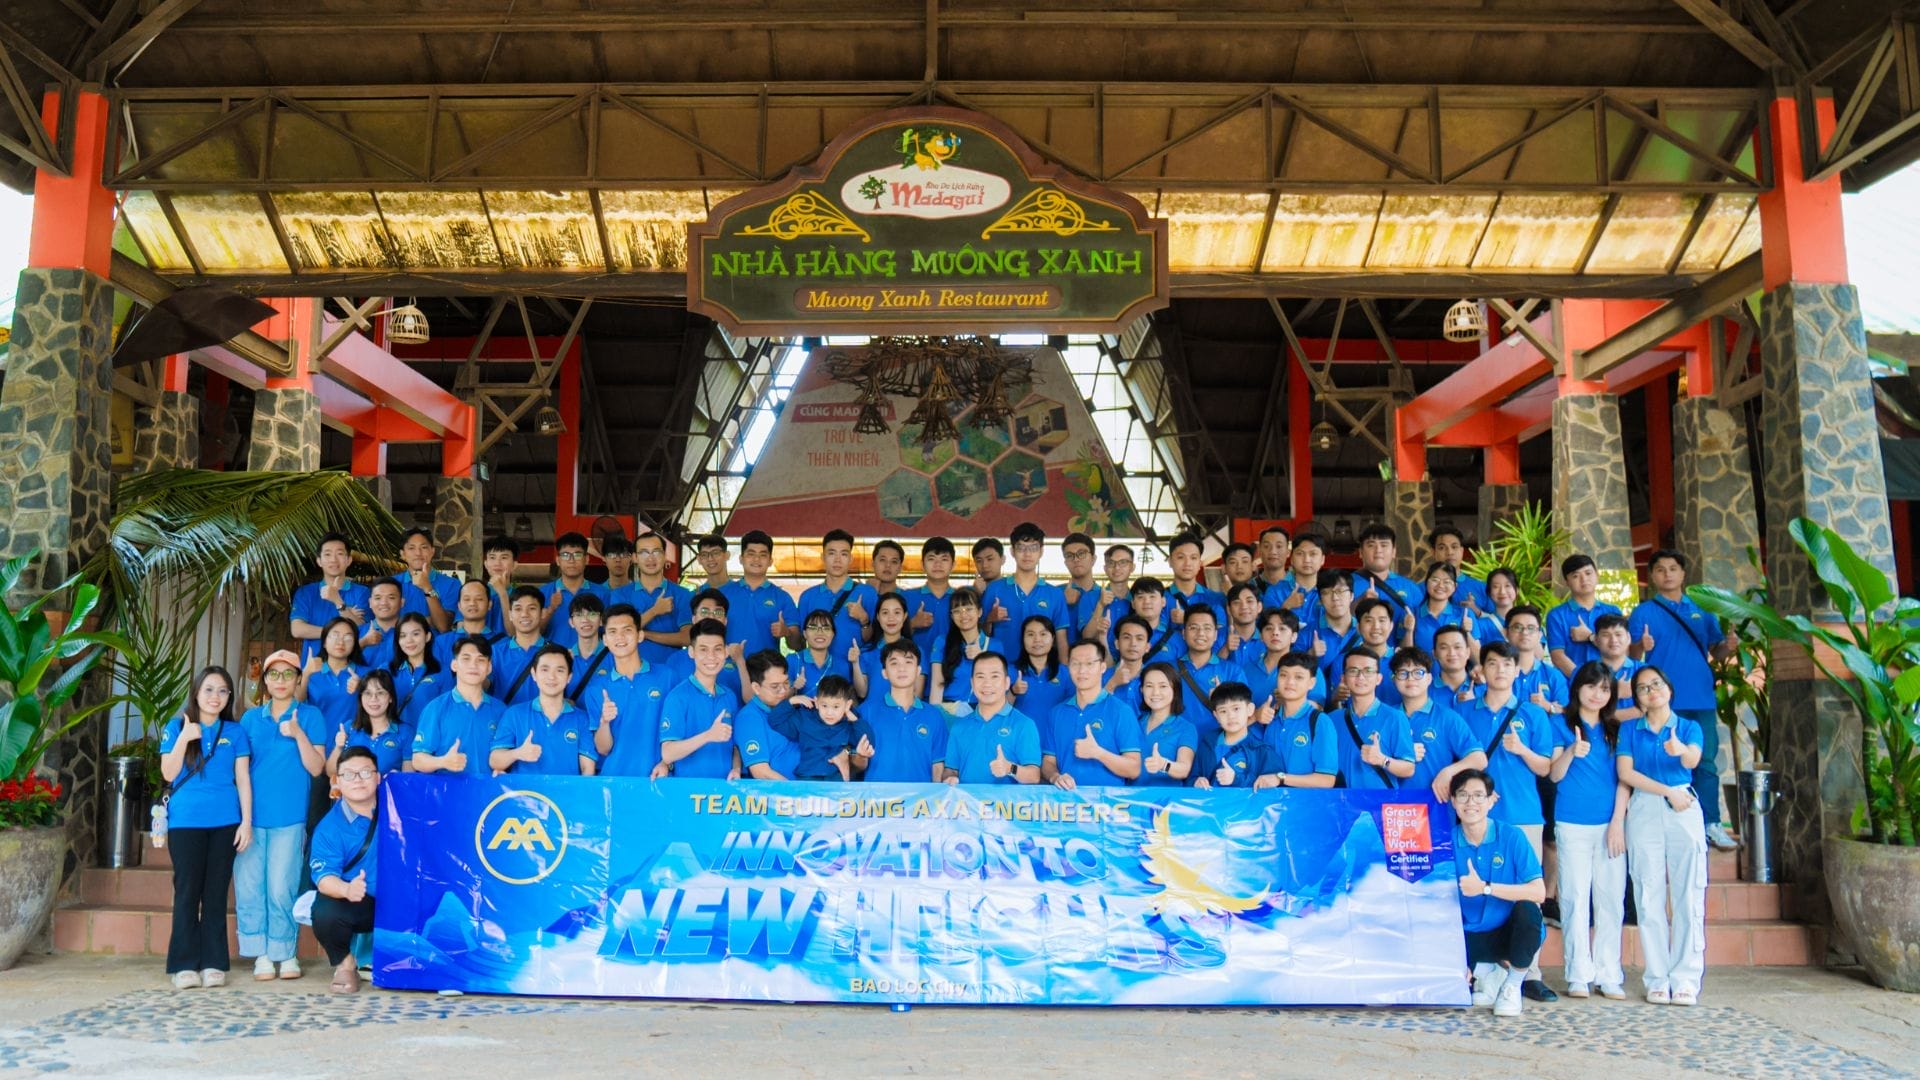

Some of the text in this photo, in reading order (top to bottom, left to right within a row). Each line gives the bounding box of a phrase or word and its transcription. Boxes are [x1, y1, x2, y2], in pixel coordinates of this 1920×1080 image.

[711, 243, 1142, 277] NHÀ HÀNG MUÔNG XANH
[878, 289, 931, 308] Xanh
[937, 289, 1049, 308] Restaurant
[808, 450, 879, 467] THIÊN NHIÊN
[690, 794, 1133, 823] TEAM BUILDING AXA ENGINEERS
[1385, 807, 1418, 817] Great
[1386, 818, 1417, 827] Place
[487, 817, 556, 850] AXA
[1387, 828, 1400, 837] To
[708, 830, 1111, 880] INNOVATION TO
[1390, 854, 1429, 863] Certified
[595, 884, 825, 958] NEW
[850, 978, 891, 994] BAO
[895, 979, 930, 995] LOC
